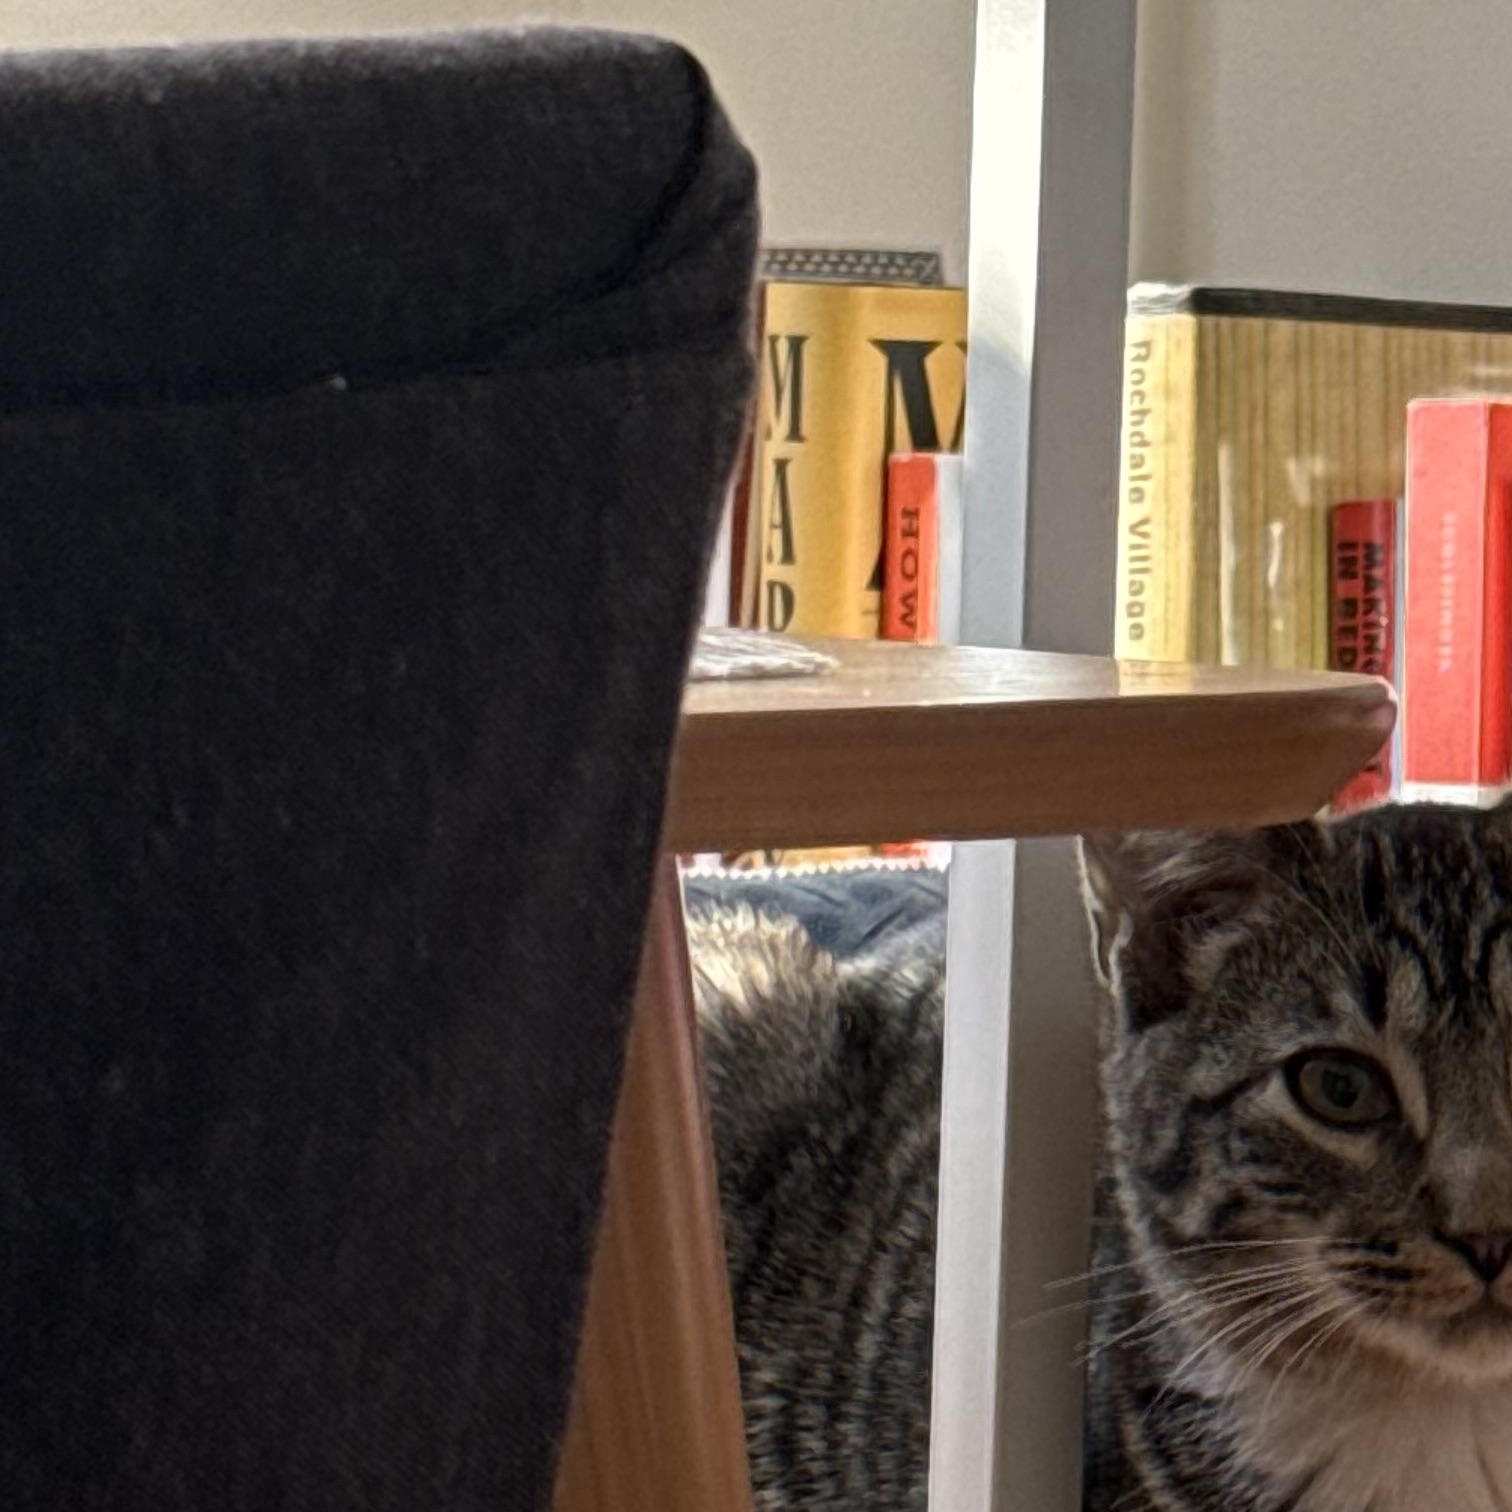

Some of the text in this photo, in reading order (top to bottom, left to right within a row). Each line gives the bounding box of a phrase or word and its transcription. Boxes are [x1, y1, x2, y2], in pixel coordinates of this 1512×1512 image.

[899, 506, 919, 629] HOW
[1125, 339, 1153, 642] Rochdale Village
